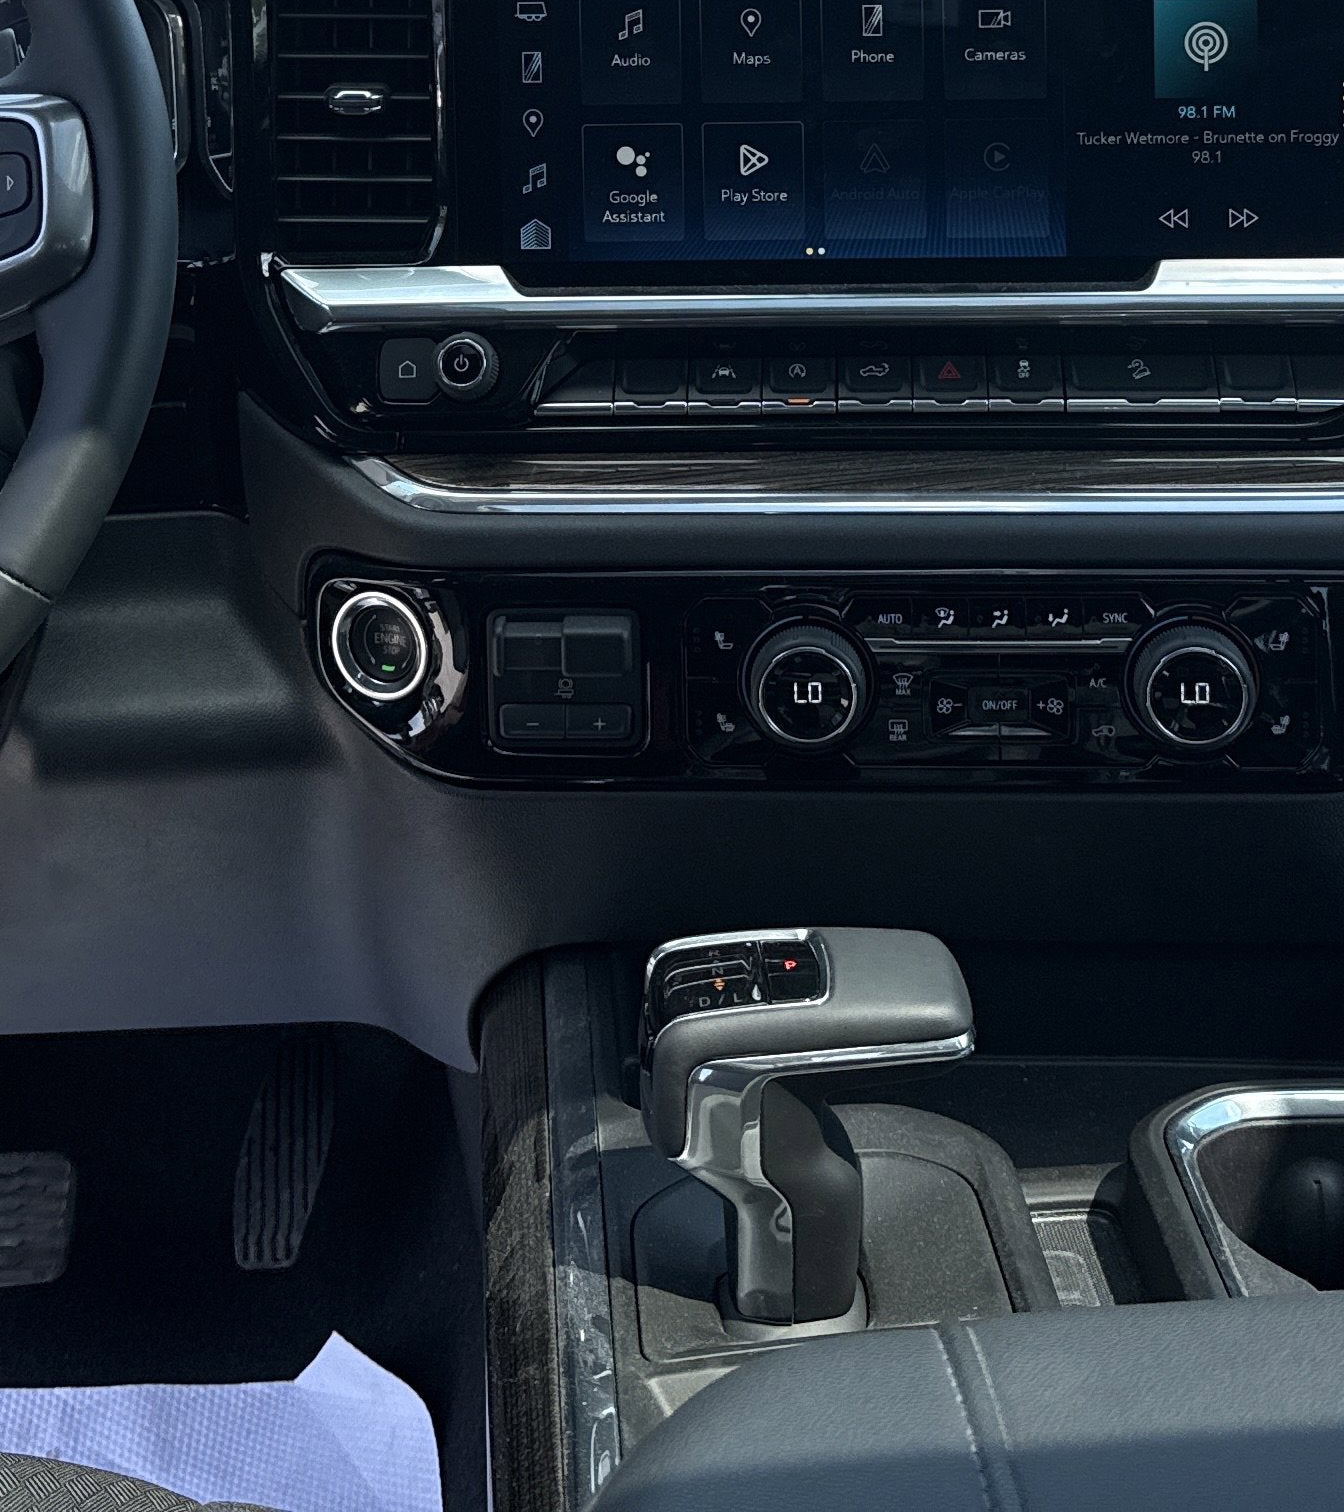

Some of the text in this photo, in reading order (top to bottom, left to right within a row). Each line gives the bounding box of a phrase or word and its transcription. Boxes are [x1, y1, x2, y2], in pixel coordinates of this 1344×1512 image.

[611, 53, 651, 68] Audio
[732, 52, 771, 69] Maps
[850, 50, 895, 64] Phone
[964, 47, 1027, 63] Cameras
[1178, 106, 1236, 119] 98.1 FM
[1076, 132, 1122, 146] Tucker
[1124, 131, 1189, 145] Wetmore
[1204, 130, 1265, 144] Brunette
[1268, 133, 1286, 144] on
[1290, 130, 1340, 147] Froggy
[1191, 150, 1222, 164] 98.1
[609, 190, 658, 208] Google
[720, 188, 788, 205] Play Store
[602, 209, 665, 224] Assistant
[877, 613, 903, 625] AUTO
[1102, 612, 1128, 625] SYNC
[374, 632, 407, 647] ENGINE
[1089, 677, 1107, 689] A/C
[793, 682, 822, 704] LO
[1180, 682, 1210, 704] LO
[981, 699, 1018, 711] ON/OFF
[784, 958, 798, 970] P
